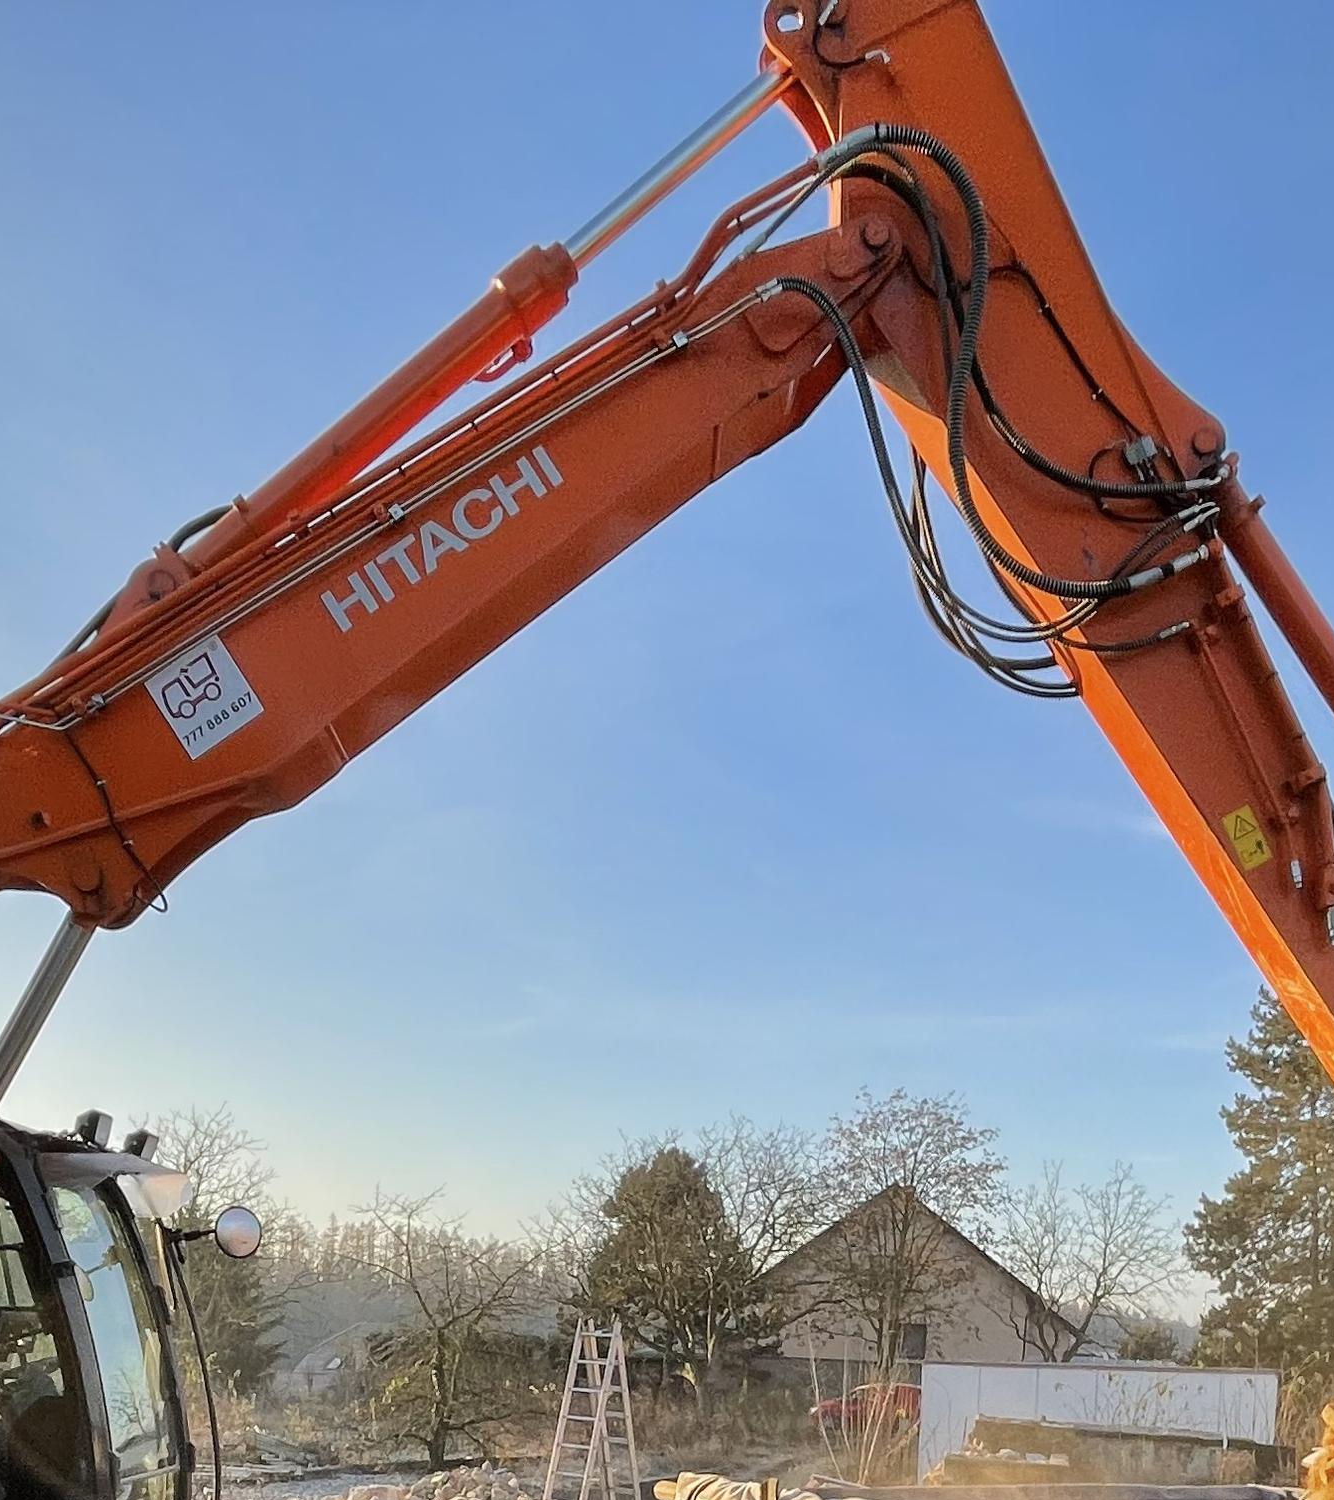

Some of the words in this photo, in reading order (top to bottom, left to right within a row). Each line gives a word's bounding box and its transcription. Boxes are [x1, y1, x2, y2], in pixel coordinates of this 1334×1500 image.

[320, 446, 564, 632] HITACHI
[183, 726, 204, 746] 777
[207, 709, 230, 730] 888
[230, 691, 252, 713] 607
